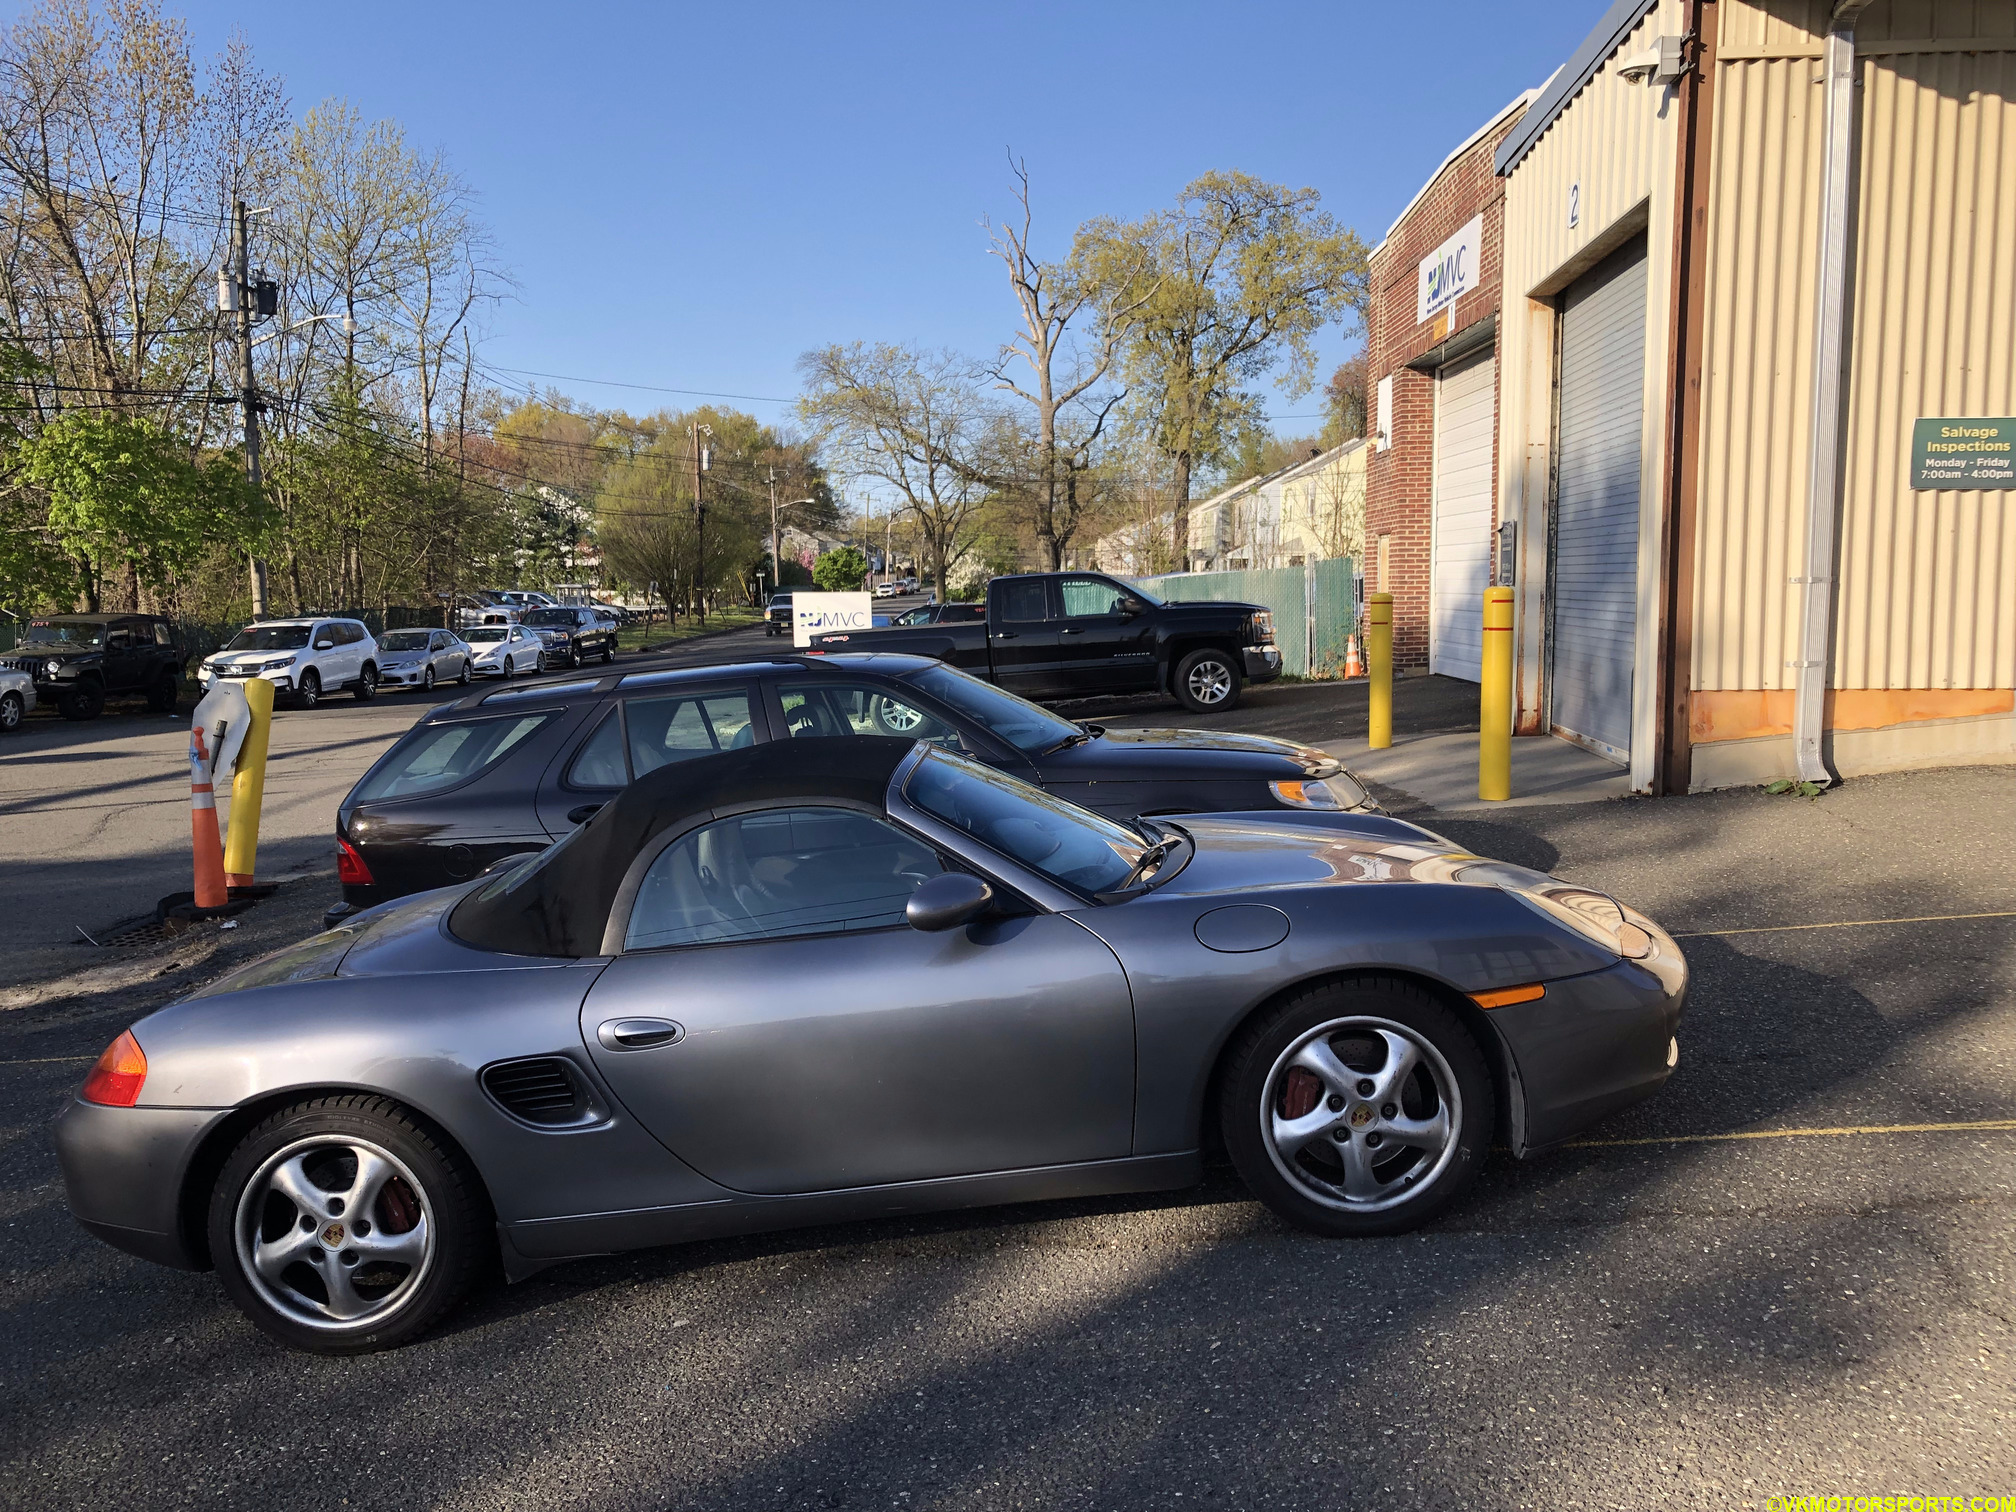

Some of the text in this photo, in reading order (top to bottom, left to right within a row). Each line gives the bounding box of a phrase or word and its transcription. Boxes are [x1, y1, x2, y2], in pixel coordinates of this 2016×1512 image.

[1570, 184, 1579, 223] 2
[1941, 426, 1999, 439] Salvage
[1927, 440, 2011, 453] Inspections
[1925, 458, 1967, 469] Monday
[1976, 457, 2010, 468] Friday
[1921, 470, 1961, 479] 7:00am
[1971, 469, 2014, 479] 4:00pm
